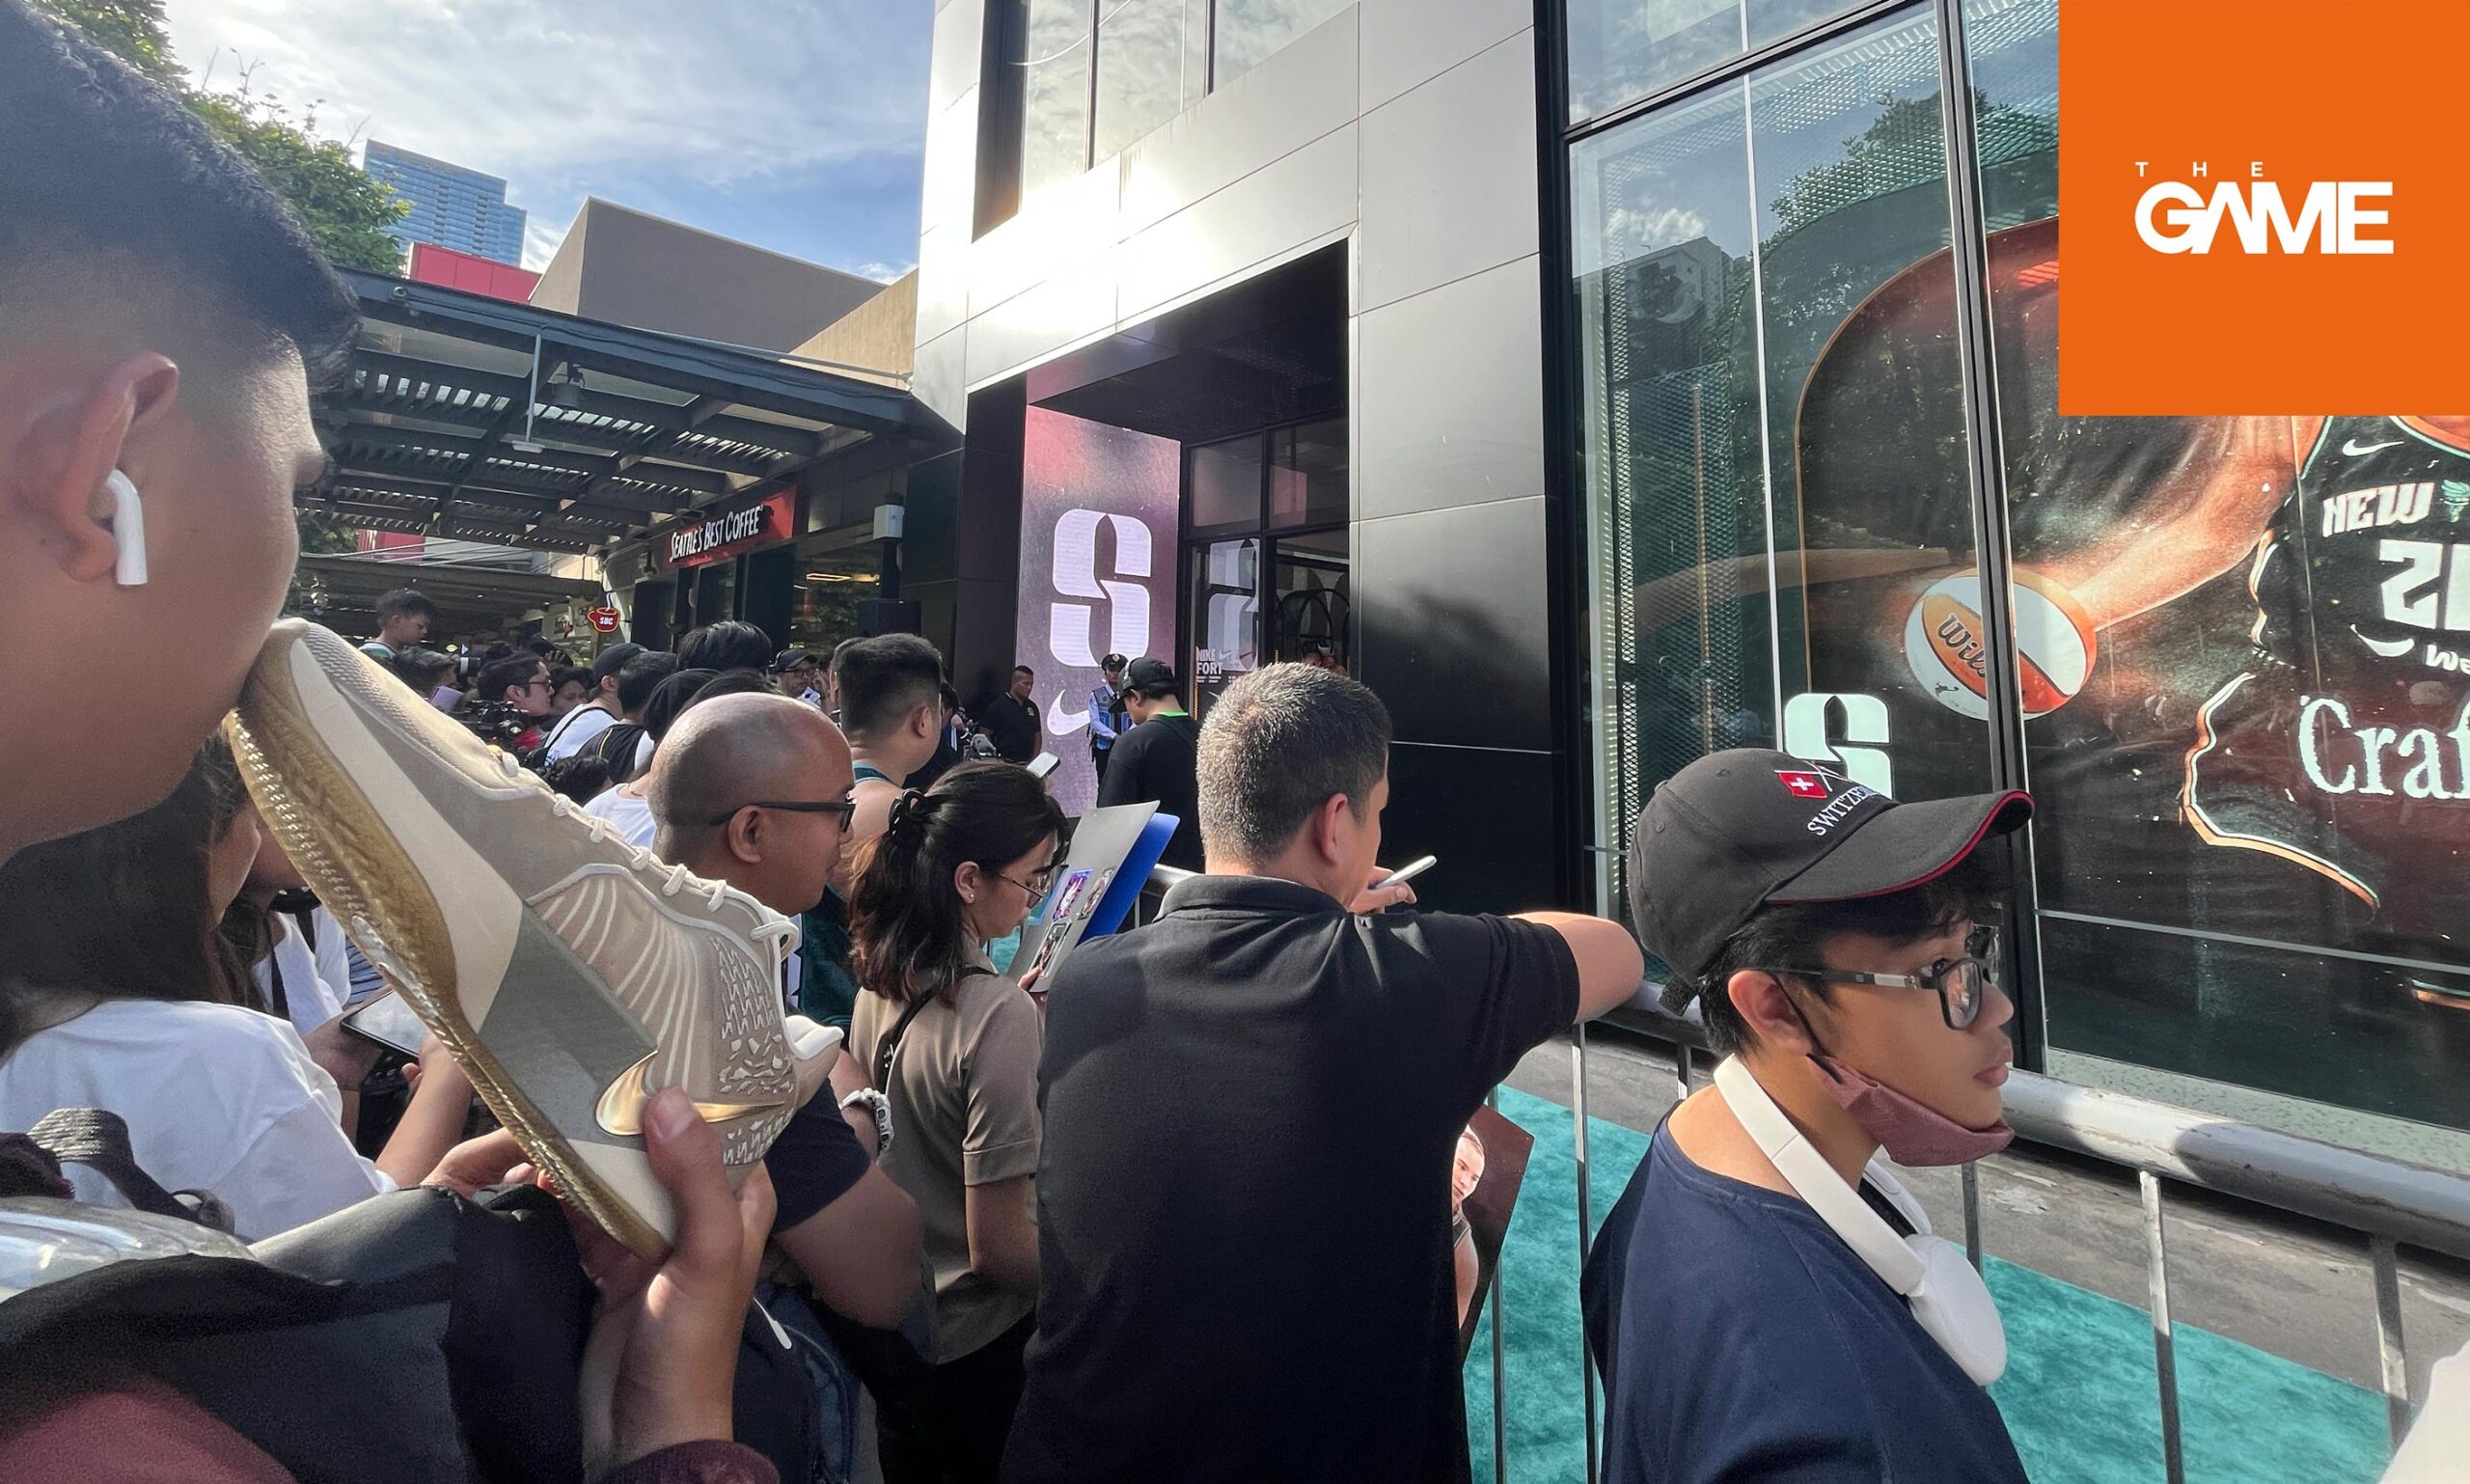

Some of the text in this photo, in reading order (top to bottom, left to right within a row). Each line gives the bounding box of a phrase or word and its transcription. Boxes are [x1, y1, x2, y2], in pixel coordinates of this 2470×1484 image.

[2322, 481, 2436, 538] NEW
[703, 520, 725, 551] BEST
[725, 505, 761, 542] COFFEE
[598, 617, 615, 626] SBC
[1196, 661, 1223, 675] FORT
